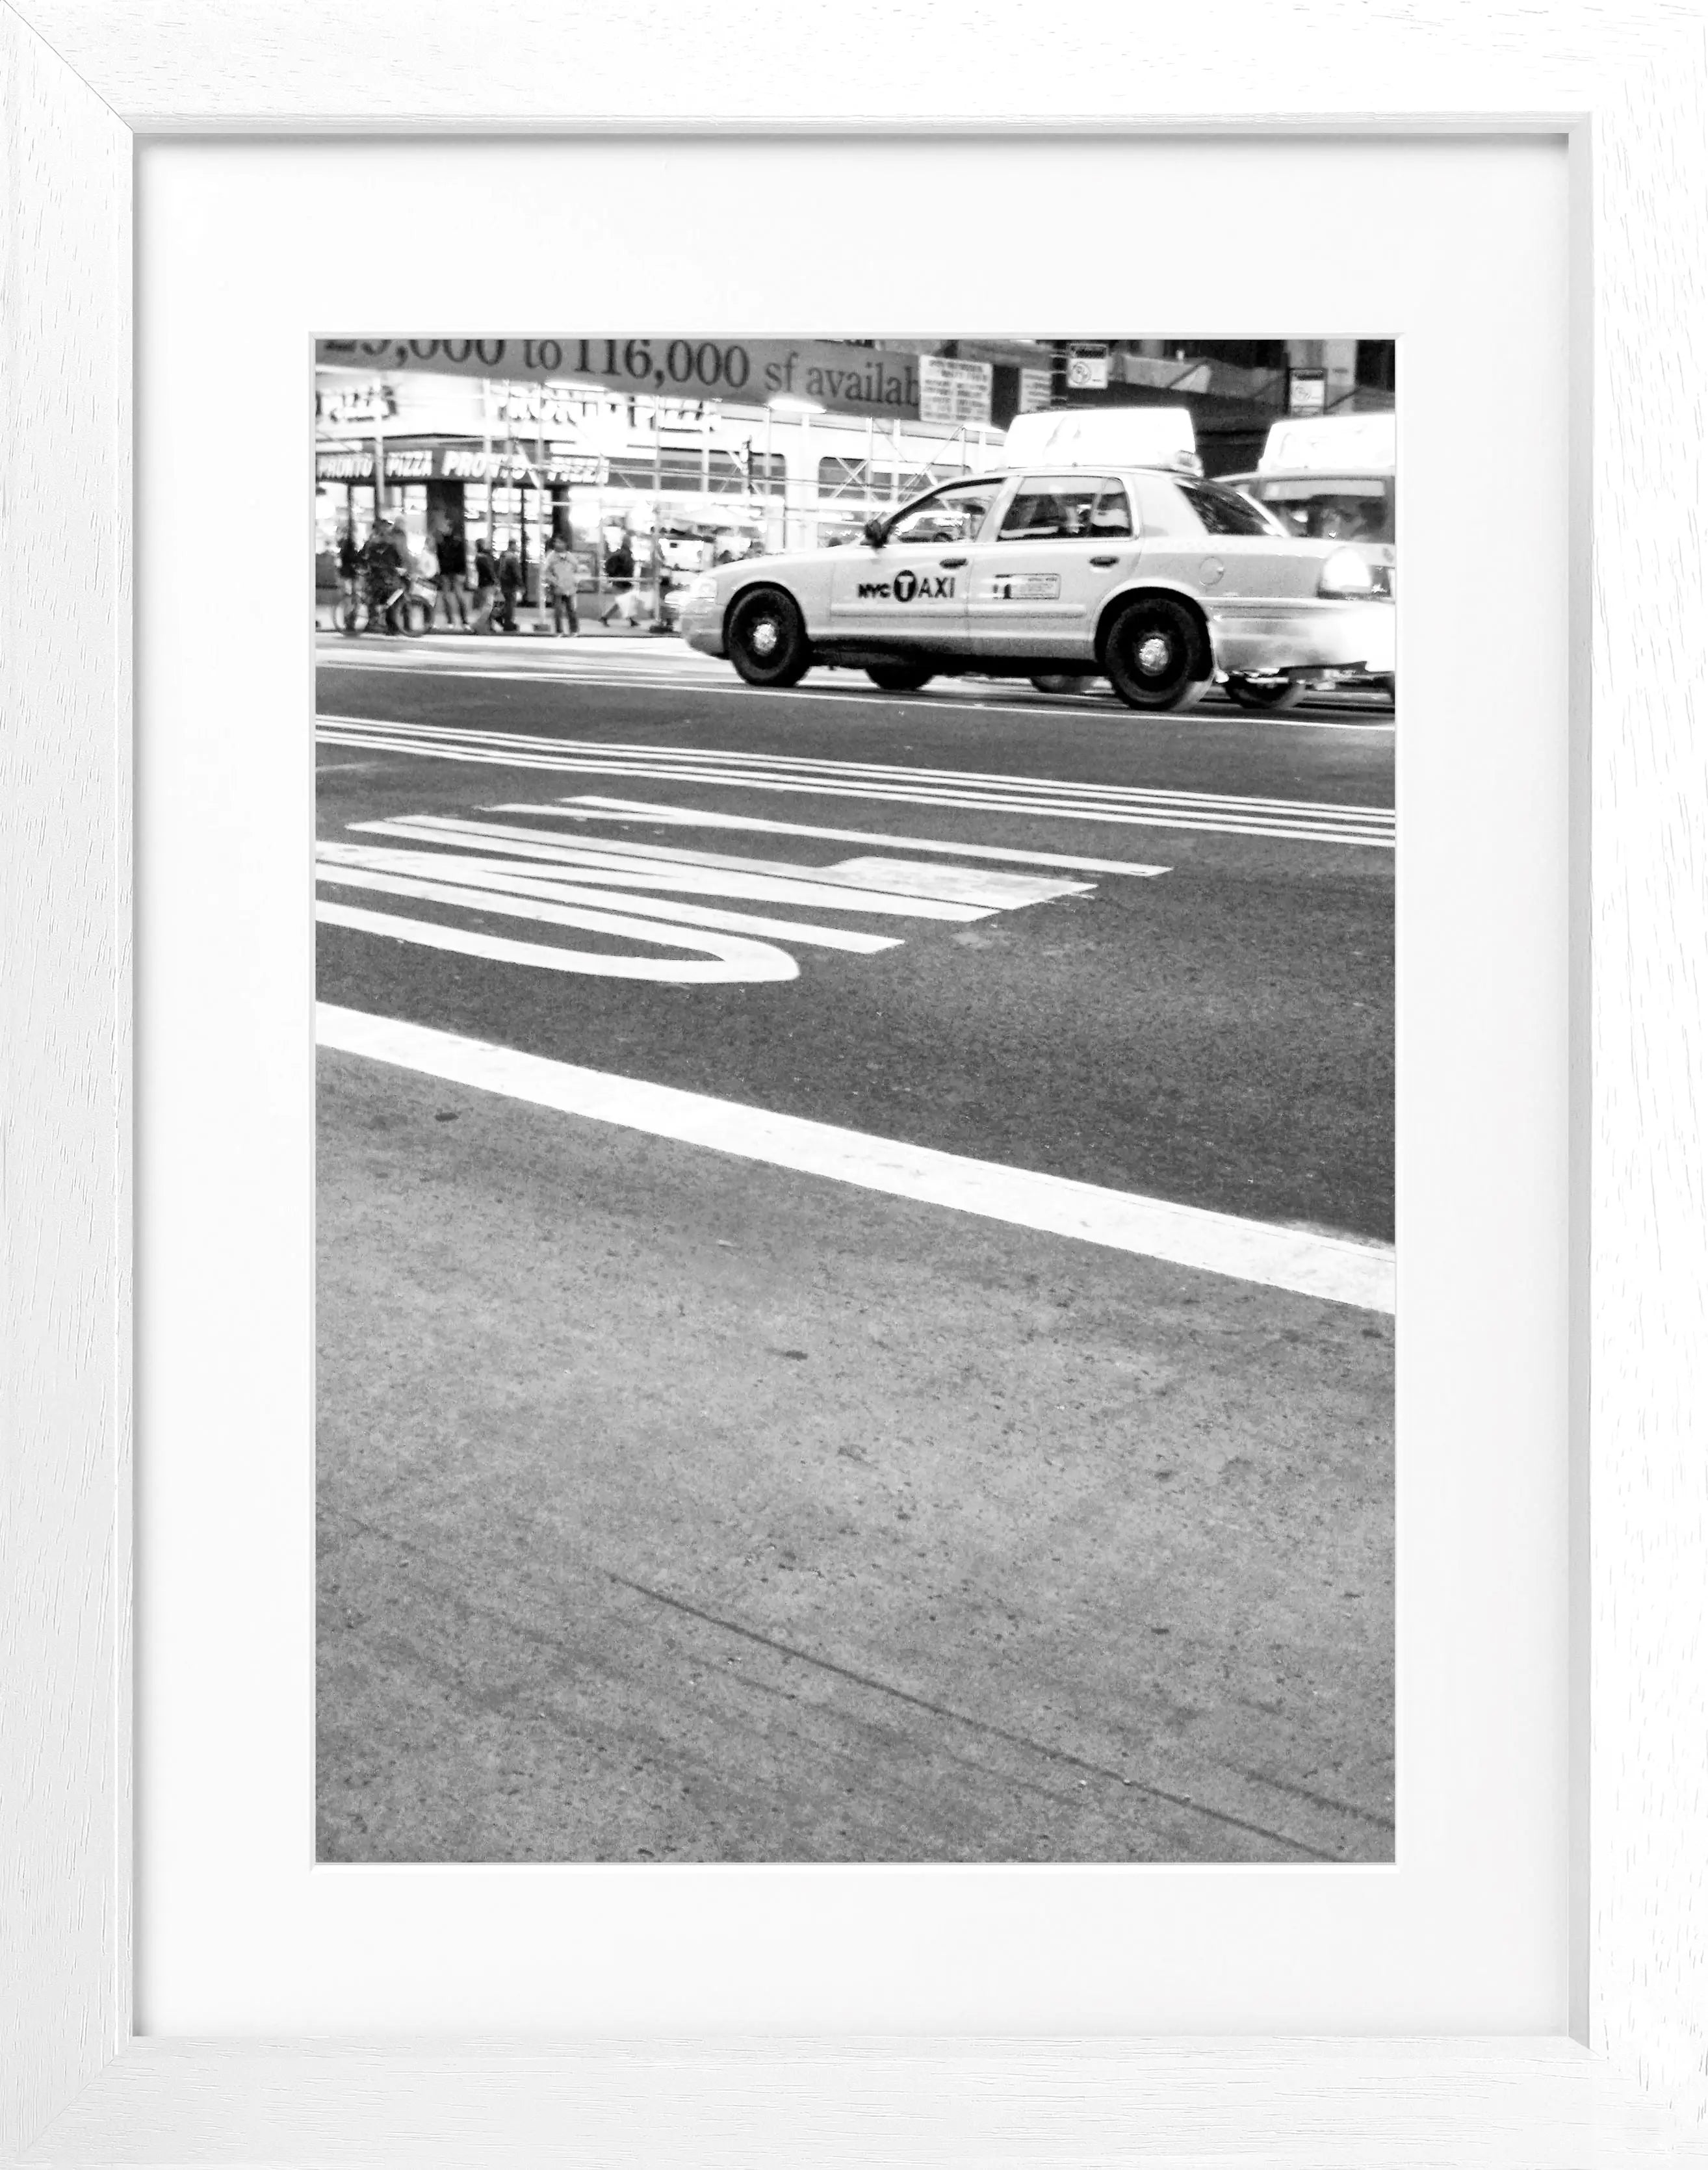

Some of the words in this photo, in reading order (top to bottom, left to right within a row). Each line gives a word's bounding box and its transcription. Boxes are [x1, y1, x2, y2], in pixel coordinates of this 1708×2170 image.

[324, 339, 505, 366] ,000
[523, 339, 563, 370] to
[575, 339, 749, 389] 116,000
[764, 351, 799, 392] sf
[387, 450, 432, 476] PIZZA
[858, 583, 890, 599] NYC
